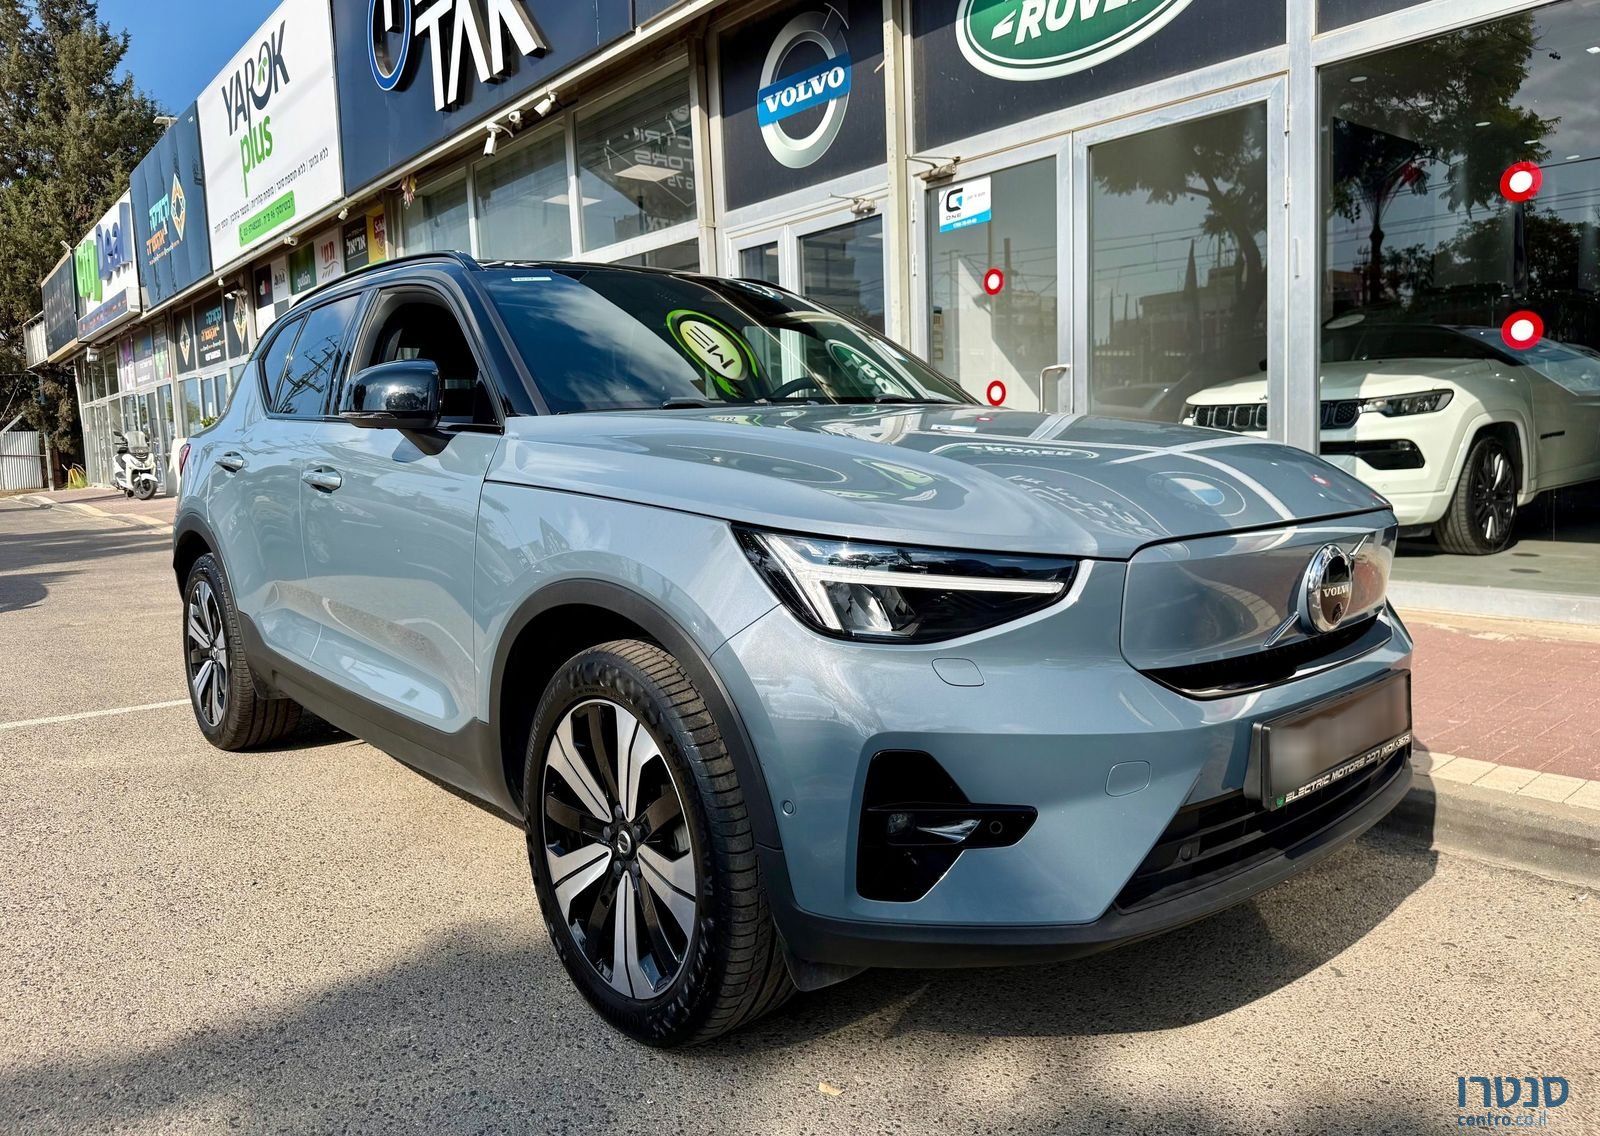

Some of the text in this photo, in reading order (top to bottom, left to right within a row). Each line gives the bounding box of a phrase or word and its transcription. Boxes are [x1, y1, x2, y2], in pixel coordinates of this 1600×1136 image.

[221, 20, 290, 136] YAROK
[763, 66, 846, 113] VOLVO
[240, 115, 273, 198] plus
[1322, 584, 1351, 598] VOLV
[1286, 774, 1330, 803] ELECTRIC
[1331, 757, 1365, 783] MOTORS
